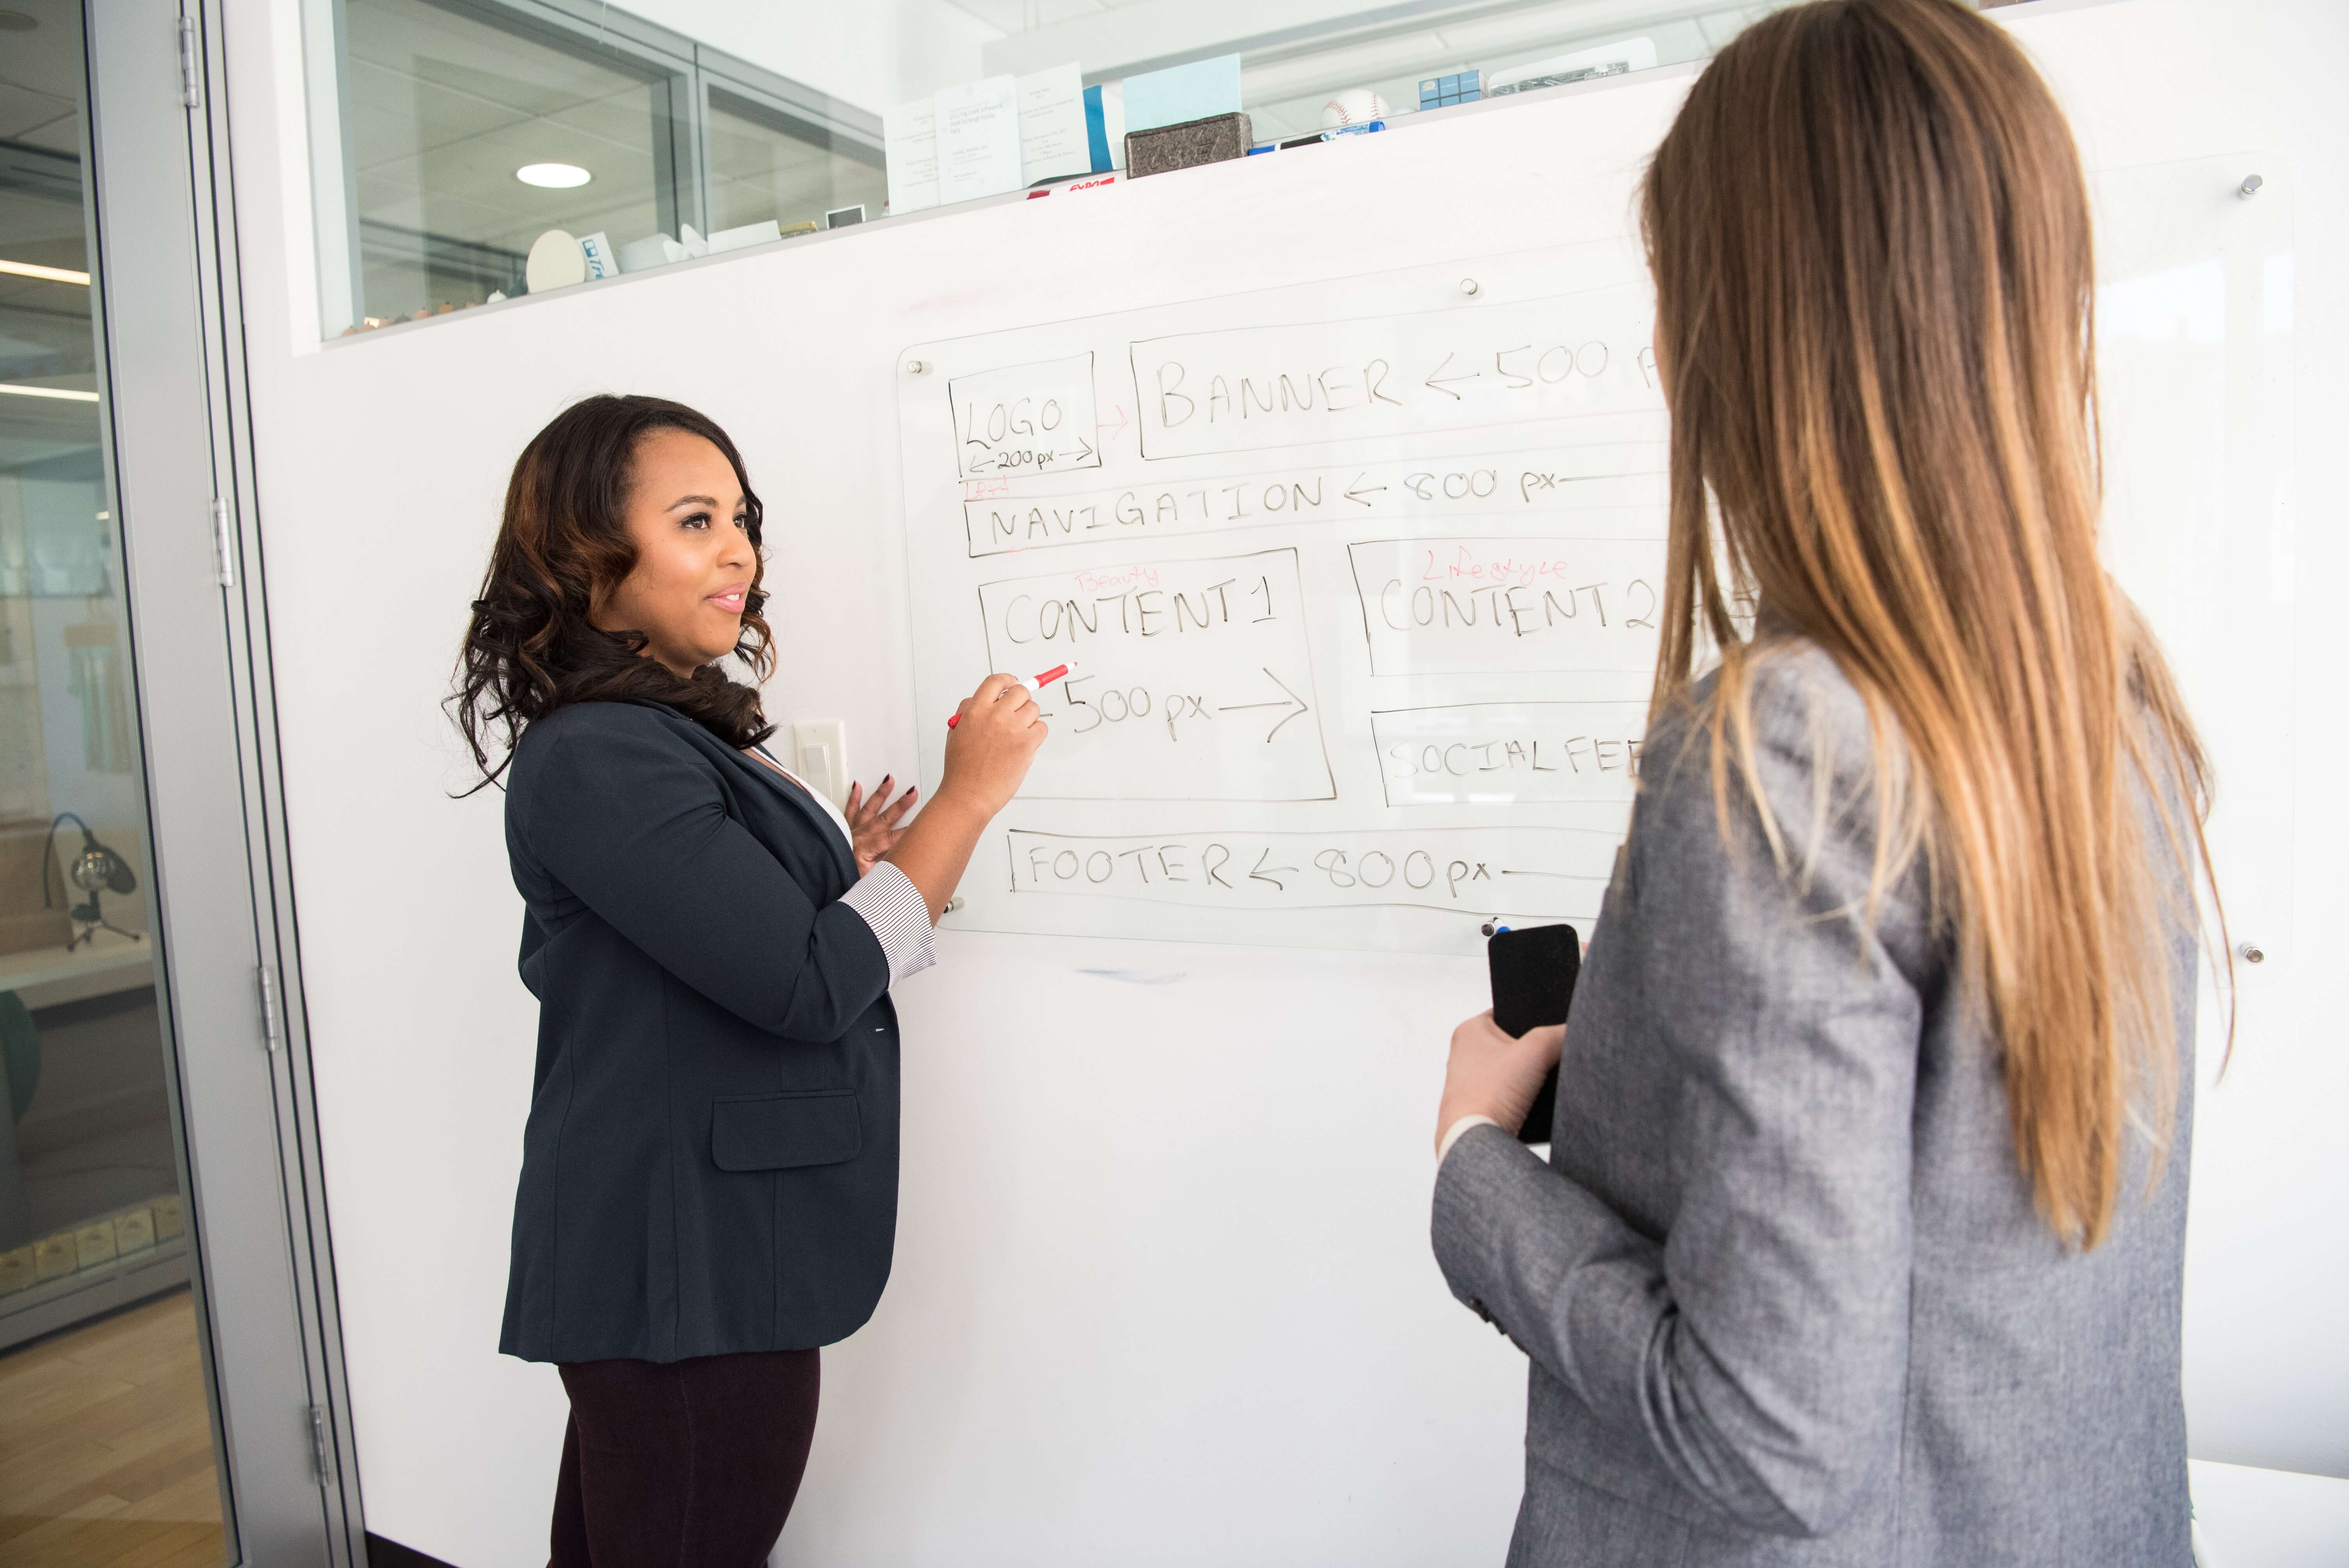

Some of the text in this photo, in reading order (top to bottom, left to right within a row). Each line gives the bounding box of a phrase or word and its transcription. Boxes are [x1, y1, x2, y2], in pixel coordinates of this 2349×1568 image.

[1159, 361, 1403, 427] BANNER
[1497, 340, 1608, 389] 500
[966, 397, 1062, 449] LOGO
[997, 450, 1054, 470] 200 px
[991, 469, 1557, 545] NAVIGATION 800 px
[1075, 565, 1159, 596] Beauty
[1381, 579, 1609, 638] CONTENT
[1624, 579, 1656, 630] 2
[1006, 576, 1277, 643] CONTENT 1
[1064, 674, 1212, 742] 500 px
[1390, 739, 1559, 779] SOCIAL
[1029, 844, 1490, 899] FOOTER 800 px
